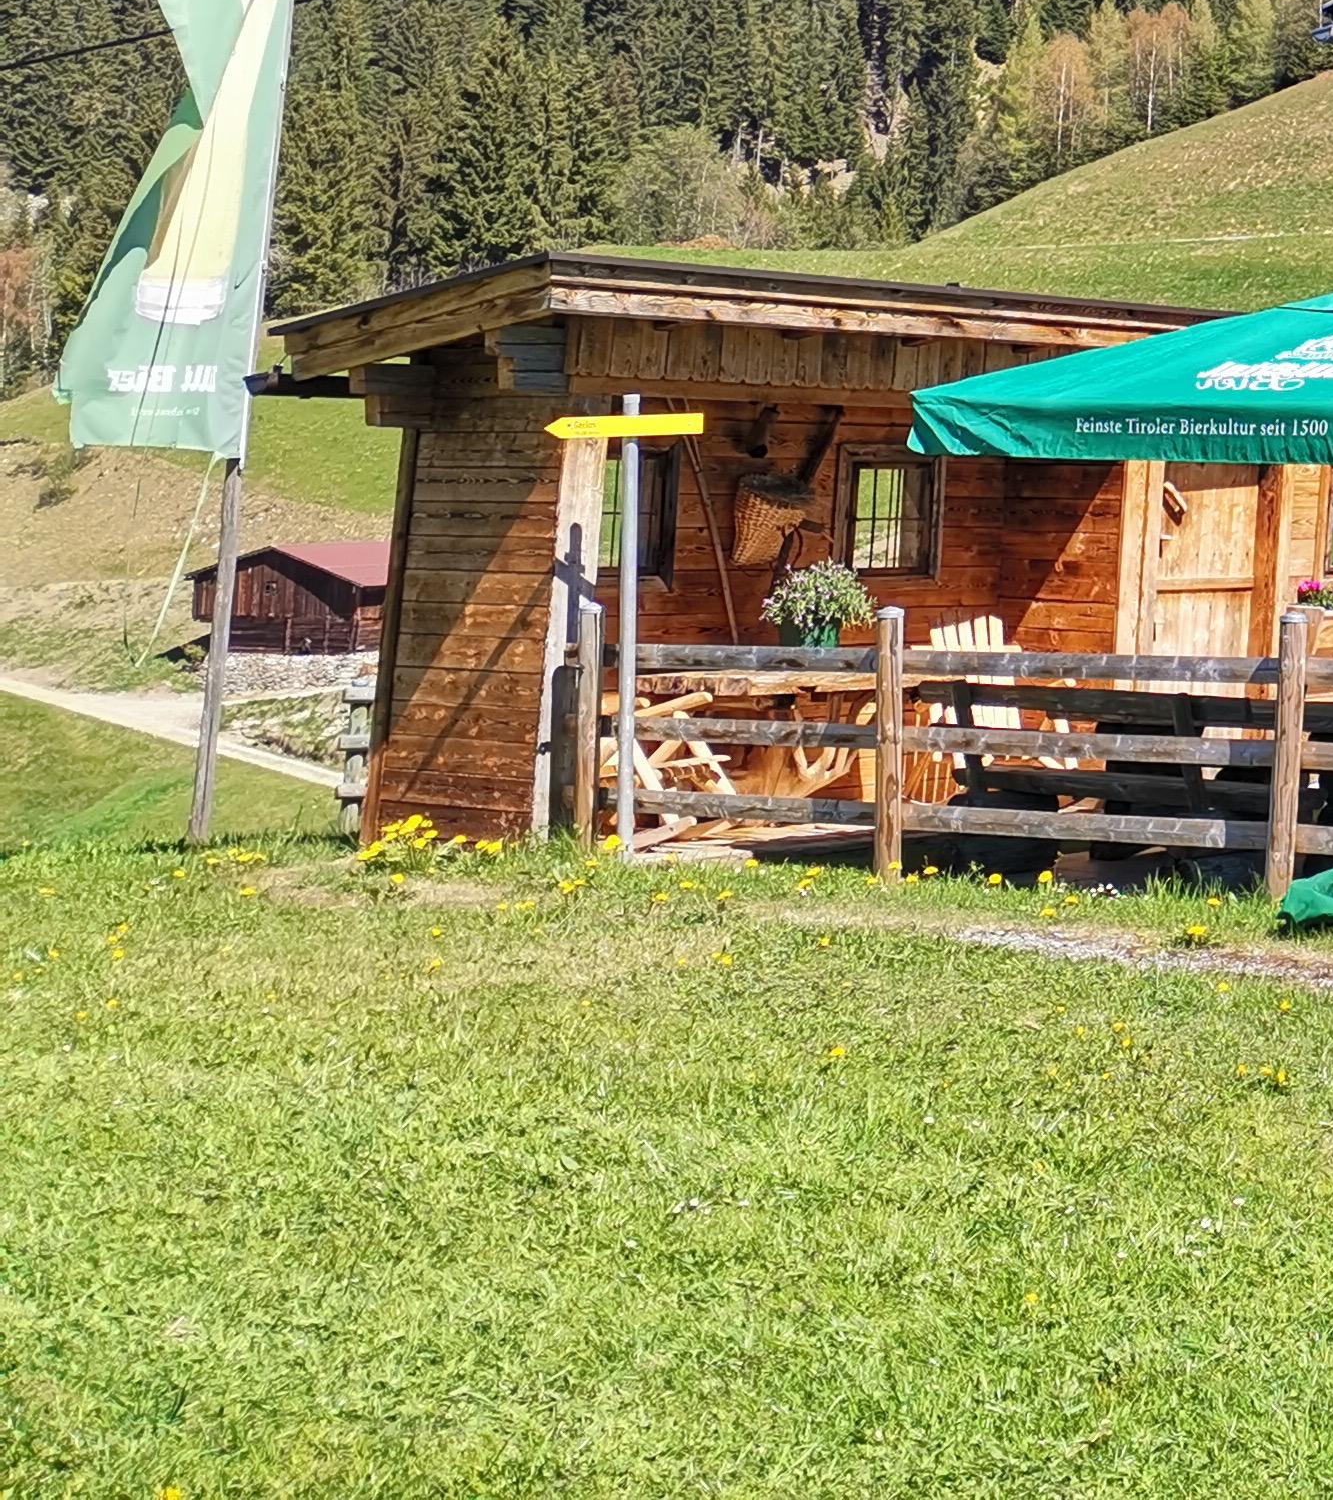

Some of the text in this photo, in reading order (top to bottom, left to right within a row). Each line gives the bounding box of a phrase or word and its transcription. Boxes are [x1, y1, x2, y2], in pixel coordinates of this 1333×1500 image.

[1074, 417, 1329, 436] Feinste Tiroler Bierkultur seit 1500
